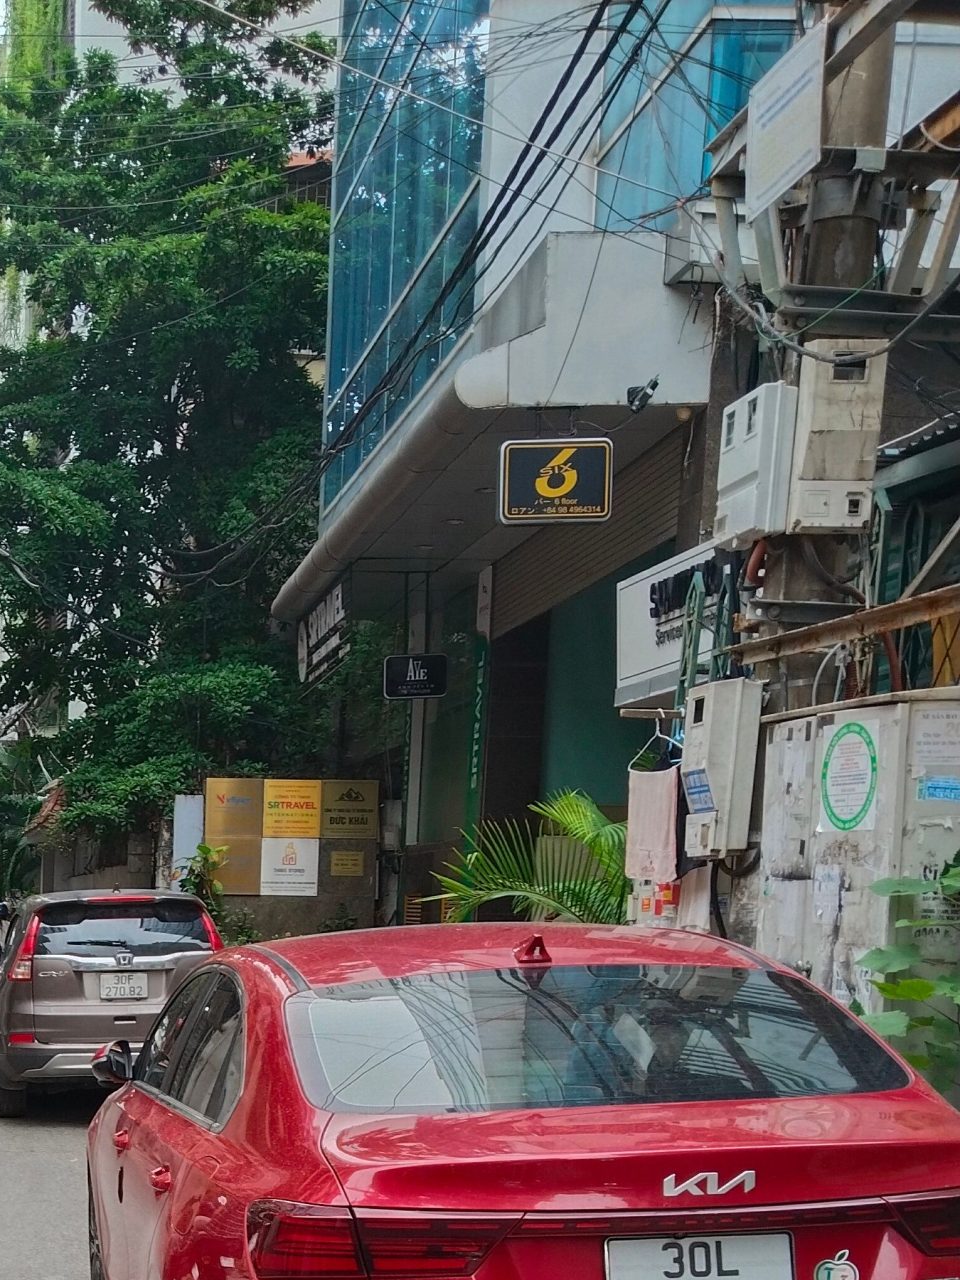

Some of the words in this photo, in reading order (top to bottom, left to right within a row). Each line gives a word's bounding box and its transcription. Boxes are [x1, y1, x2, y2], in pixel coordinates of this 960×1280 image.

[539, 463, 572, 476] SIX
[561, 497, 578, 505] floor
[267, 800, 318, 810] SRTRAVEL
[113, 974, 135, 986] 30F
[105, 985, 144, 997] 270.82
[660, 1239, 740, 1280] 30L
